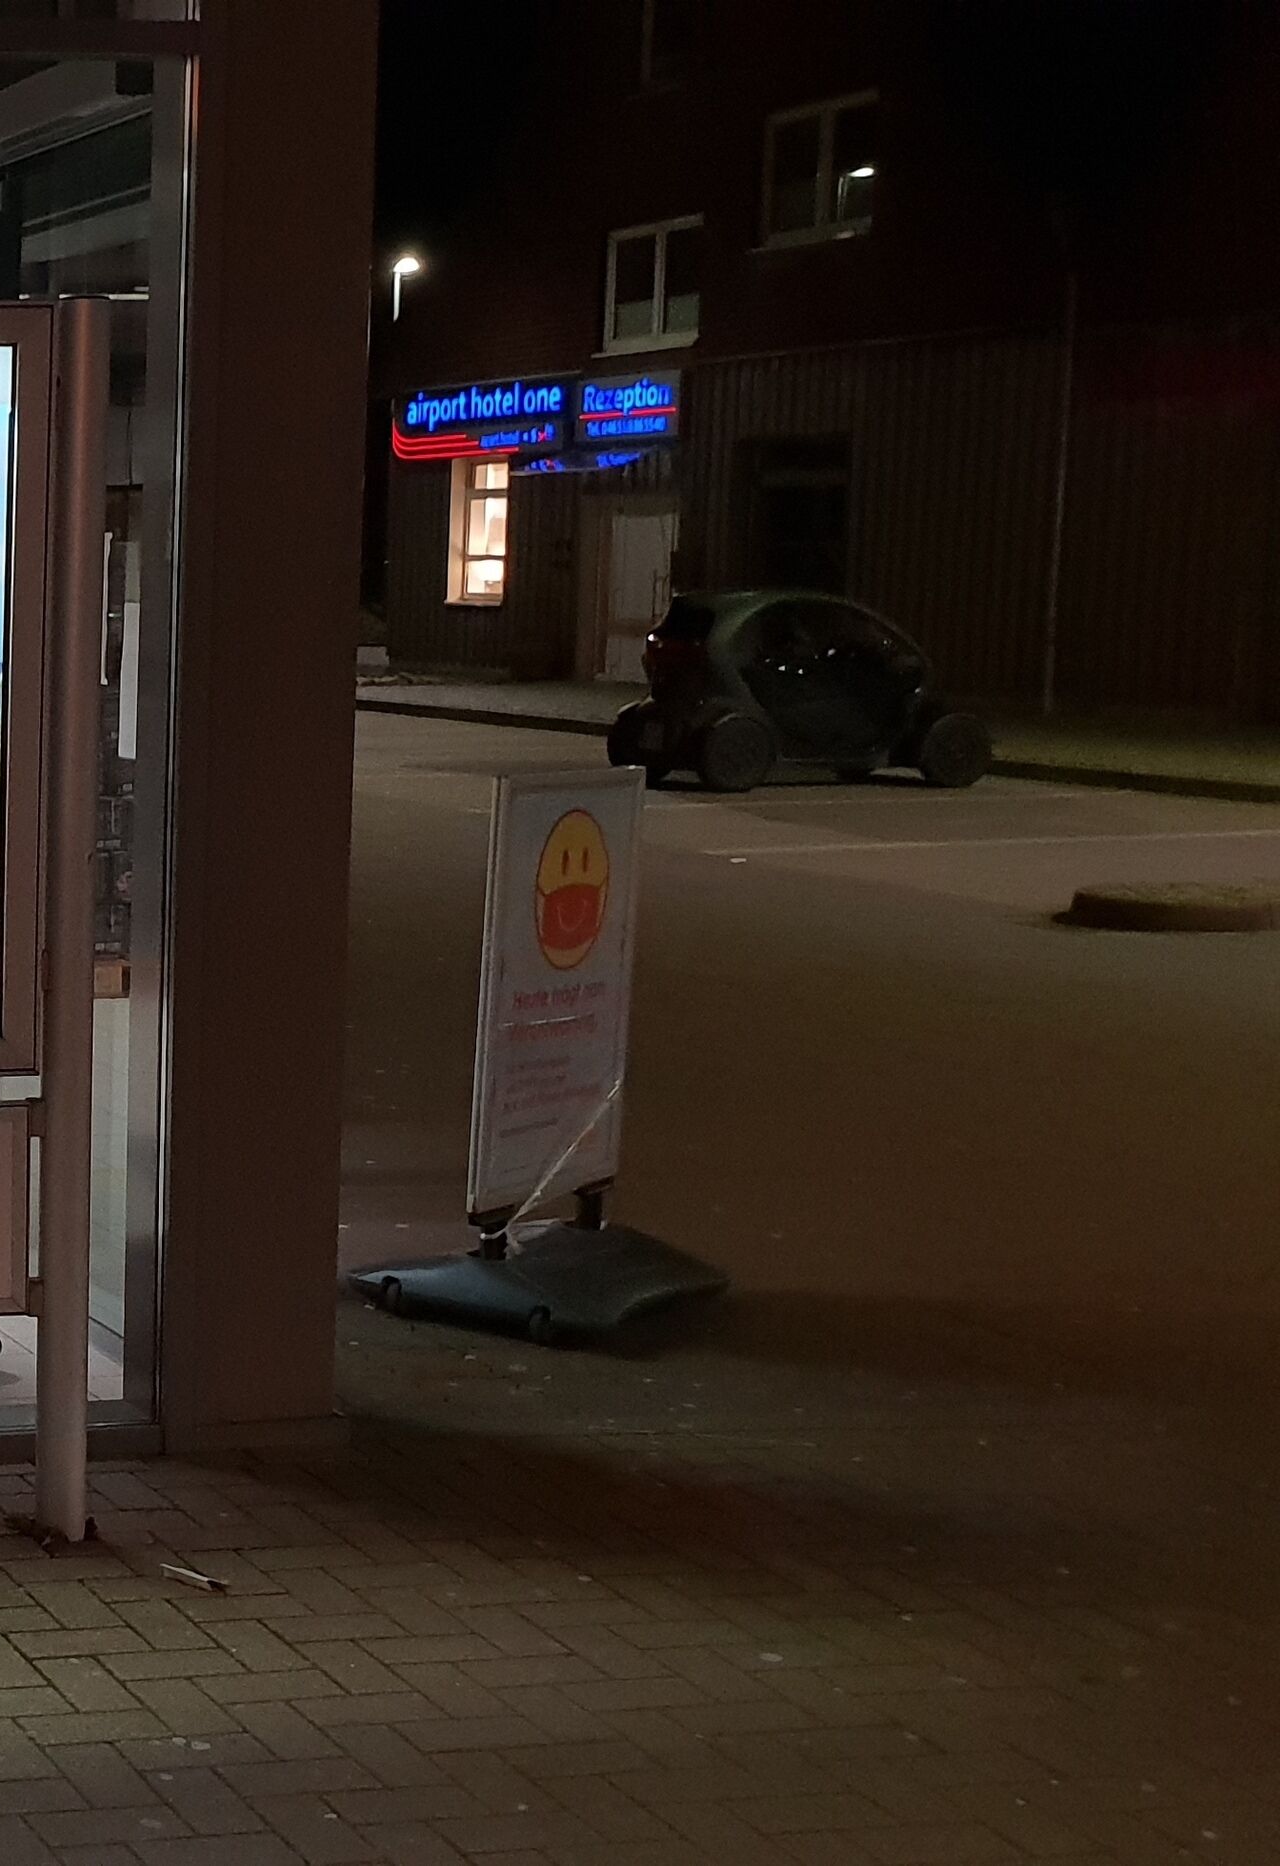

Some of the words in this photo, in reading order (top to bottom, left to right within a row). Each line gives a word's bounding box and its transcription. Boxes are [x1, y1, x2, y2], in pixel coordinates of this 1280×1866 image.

[406, 390, 467, 432] airport
[469, 381, 521, 419] hotel
[523, 385, 562, 414] one
[582, 377, 671, 416] Rezeption
